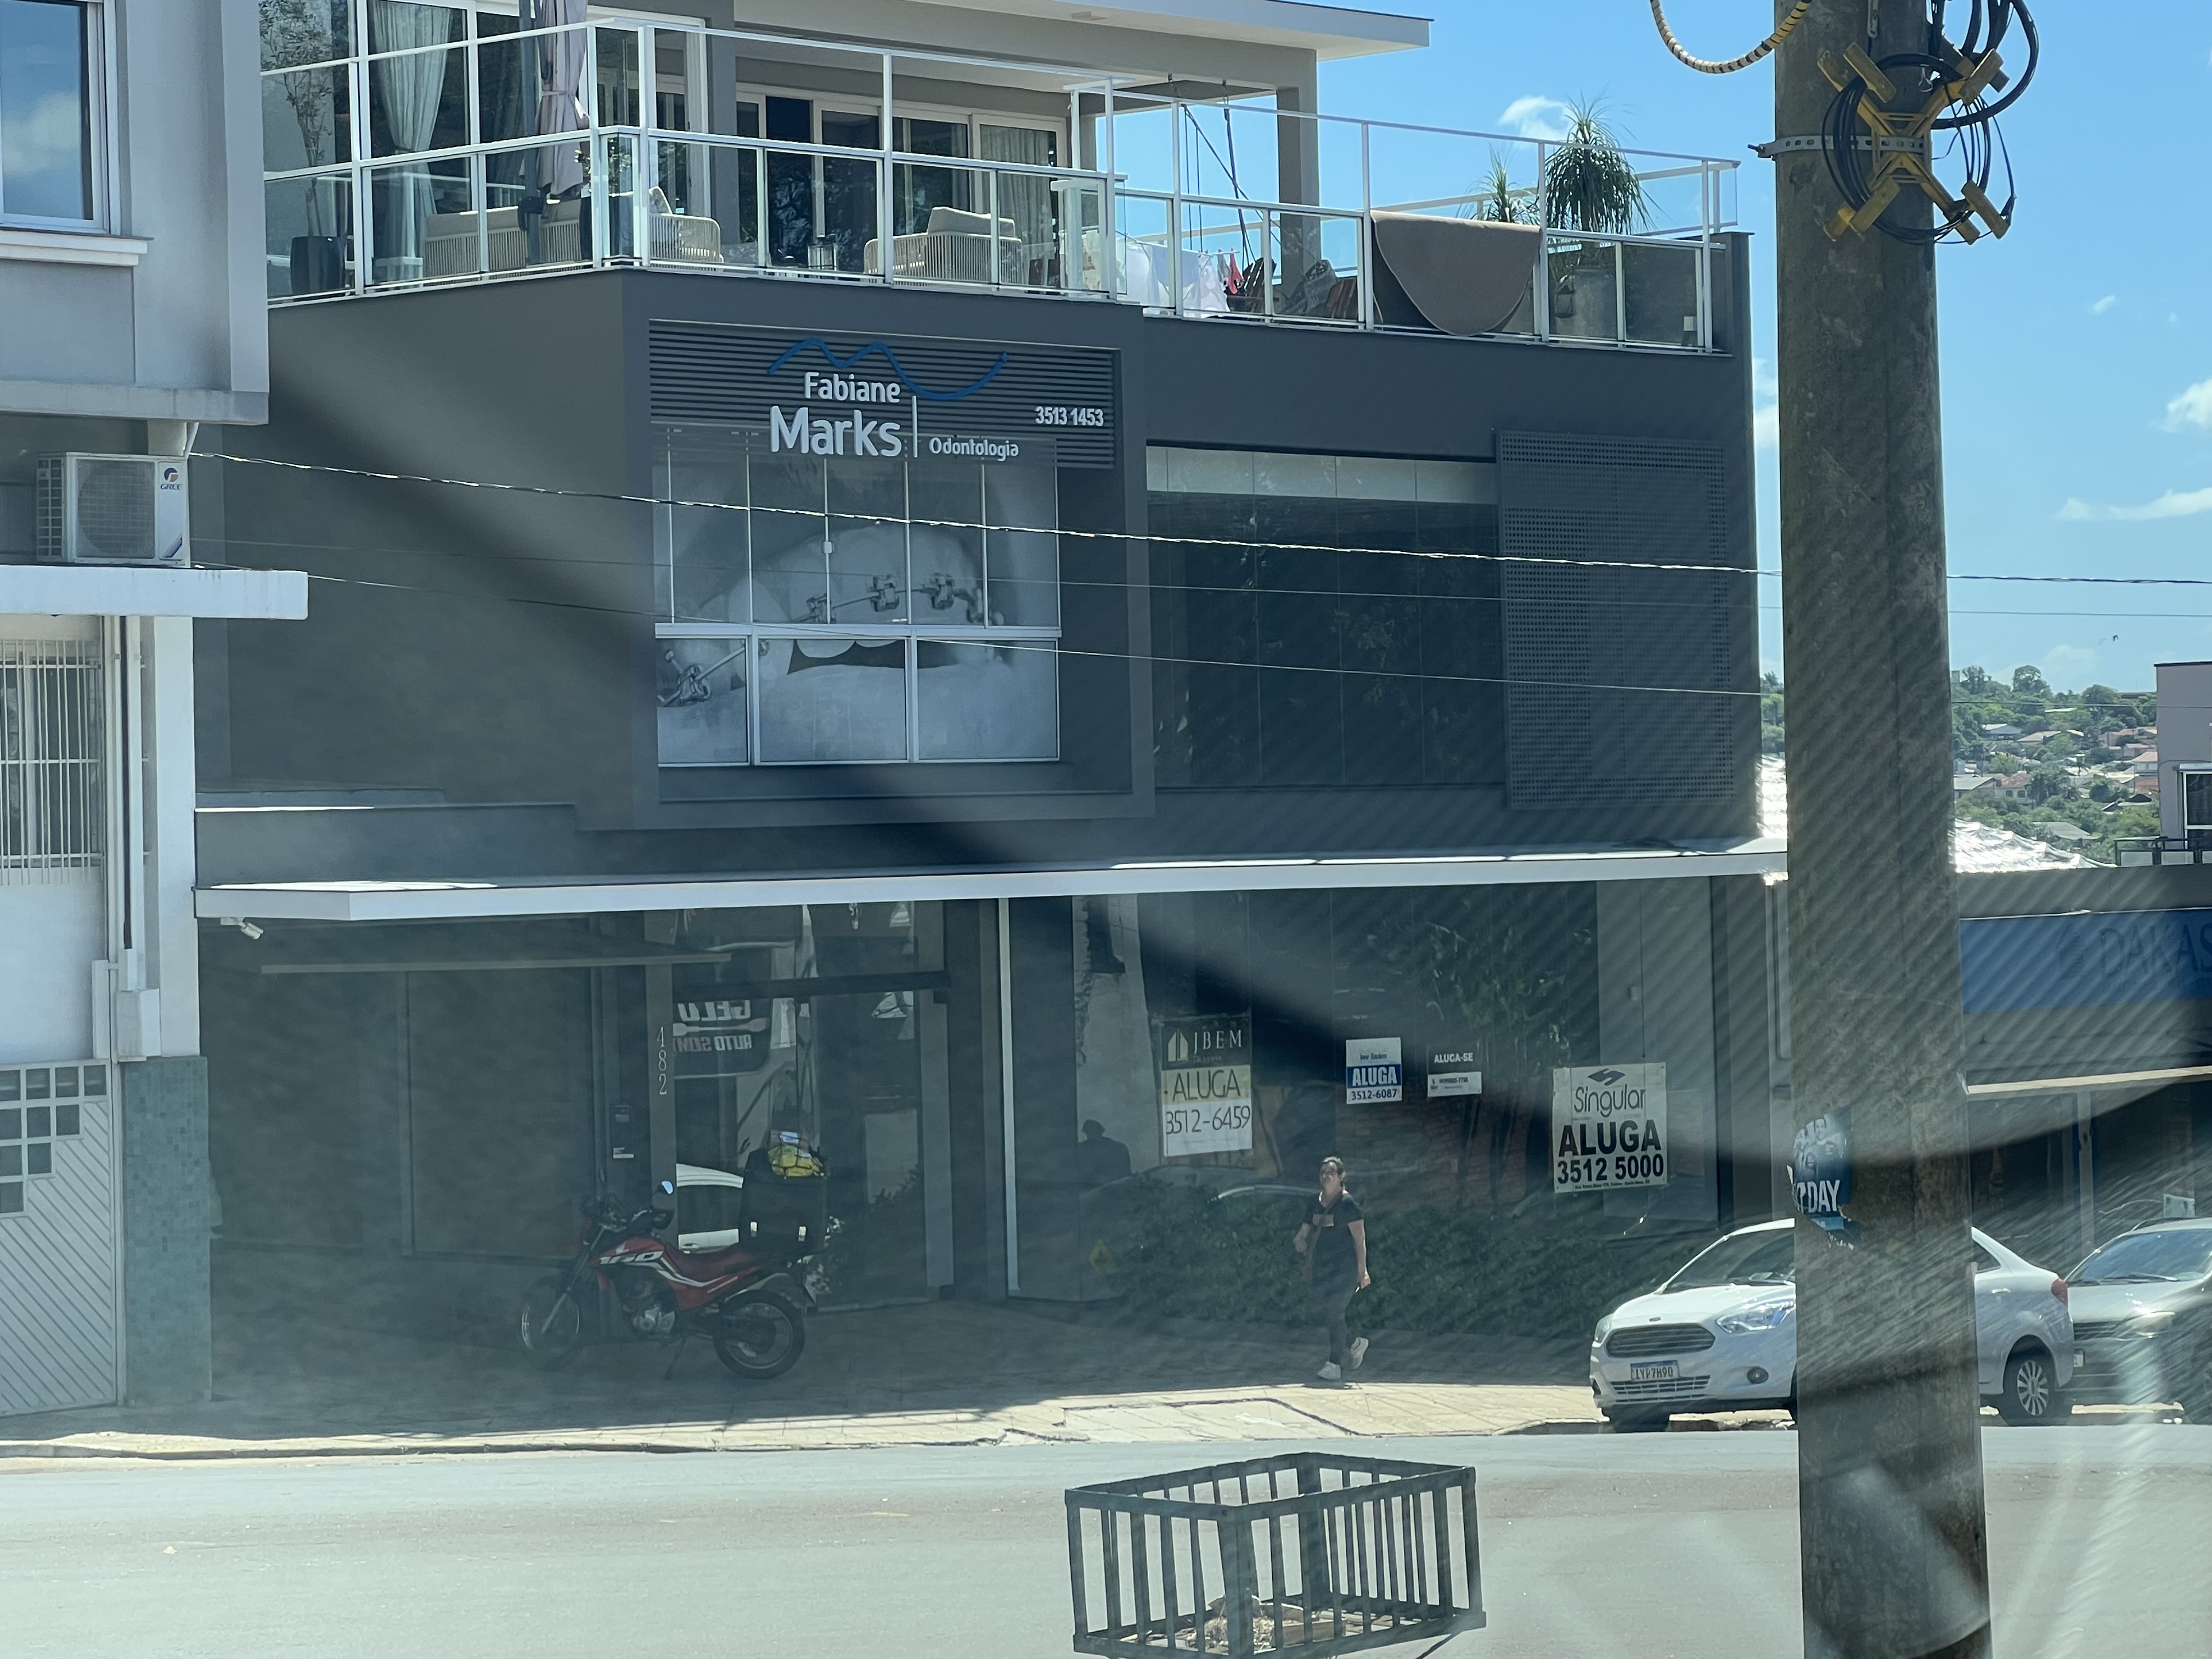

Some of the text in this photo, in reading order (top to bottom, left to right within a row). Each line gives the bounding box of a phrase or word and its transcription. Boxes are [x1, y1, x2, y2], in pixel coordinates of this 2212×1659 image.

[803, 371, 901, 404] Fabiane
[1035, 405, 1104, 427] 3513 1453
[769, 405, 903, 458] Marks
[928, 437, 1019, 462] Odontologia
[1193, 1029, 1243, 1055] JBEM
[1434, 1052, 1474, 1064] ALUGA-SE
[1172, 1069, 1242, 1102] ALUGA
[1352, 1066, 1398, 1087] ALUGA
[1351, 1088, 1398, 1101] 3512-6087
[1573, 1084, 1646, 1118] Singular
[1165, 1105, 1251, 1135] 3512-6459
[1558, 1119, 1662, 1158] ALUGA
[1557, 1153, 1664, 1184] 3512 5000
